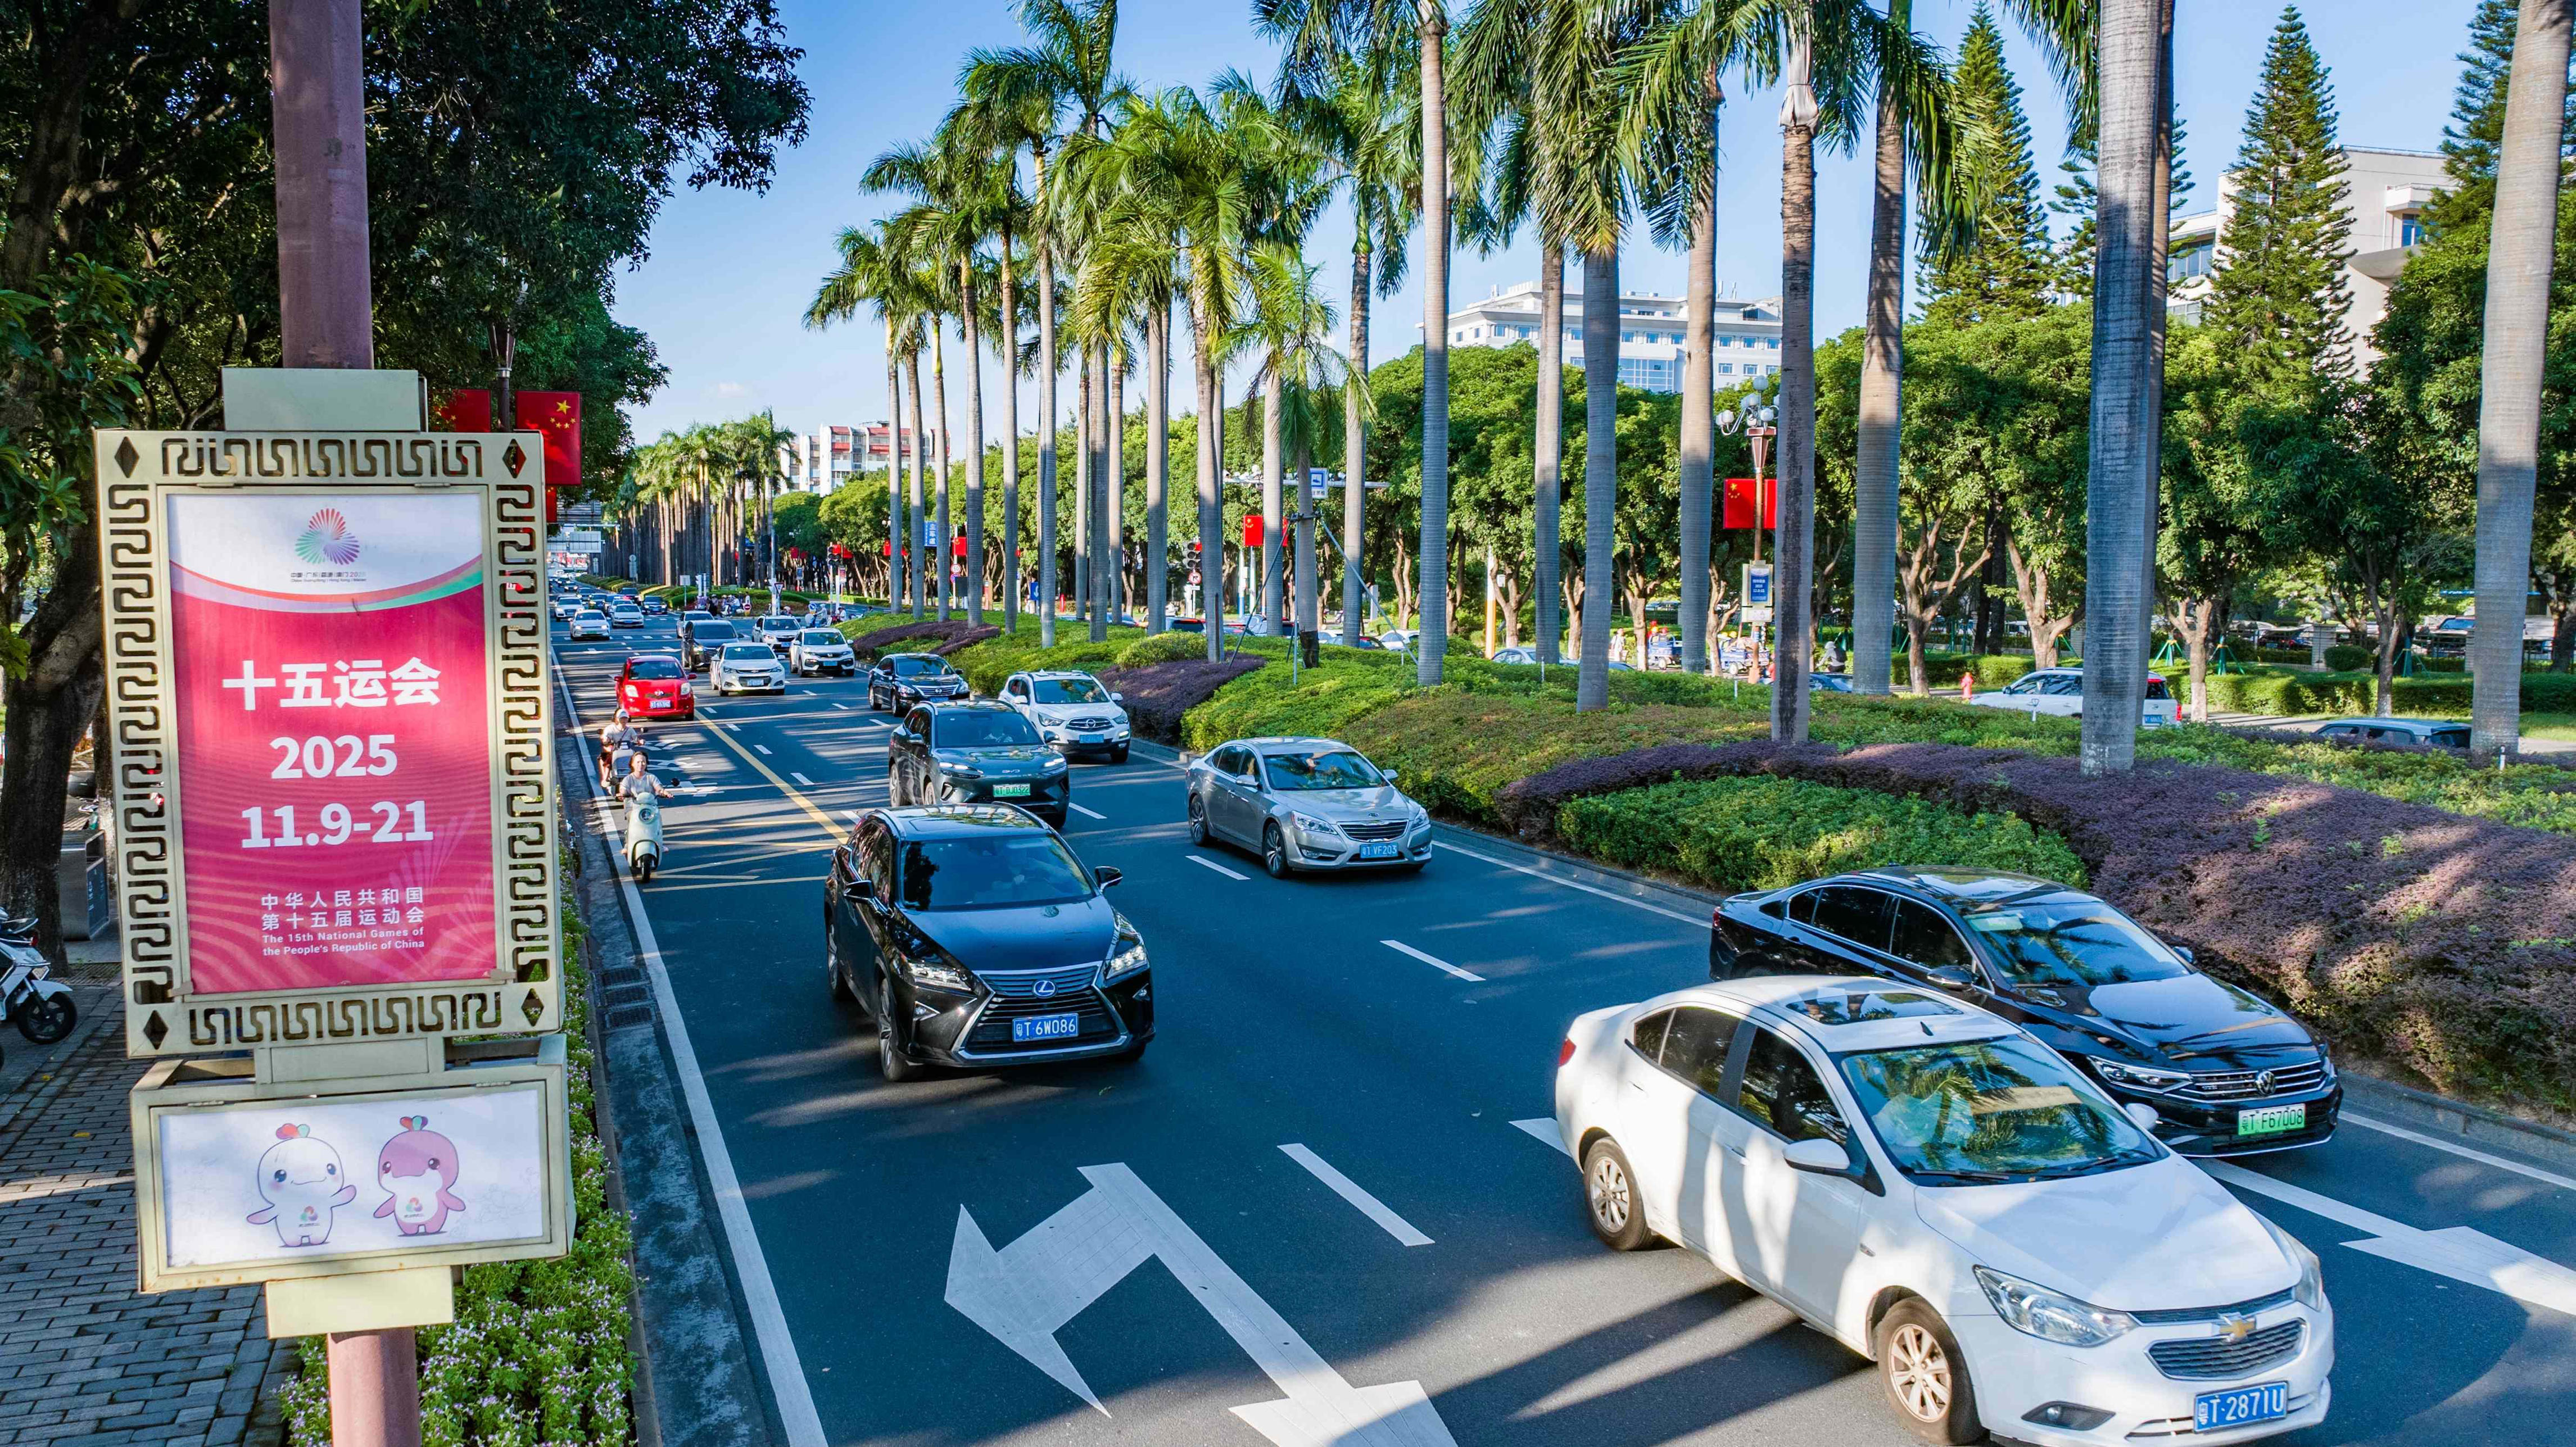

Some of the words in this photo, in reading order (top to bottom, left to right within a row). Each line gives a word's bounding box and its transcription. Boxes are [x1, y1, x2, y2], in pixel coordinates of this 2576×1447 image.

[222, 656, 441, 711] 十五运会
[270, 734, 398, 779] 2025
[242, 800, 434, 848] 11.9-21
[261, 887, 423, 910] 中华人民共和国
[262, 906, 424, 931] 第十五届运动会
[262, 935, 283, 944] The
[288, 933, 314, 942] 15th
[318, 930, 366, 941] National
[371, 929, 408, 938] Games
[412, 927, 424, 936] of
[262, 946, 280, 956] the
[284, 944, 328, 956] People's
[332, 941, 378, 953] Republic
[381, 940, 392, 949] of
[395, 939, 425, 948] China
